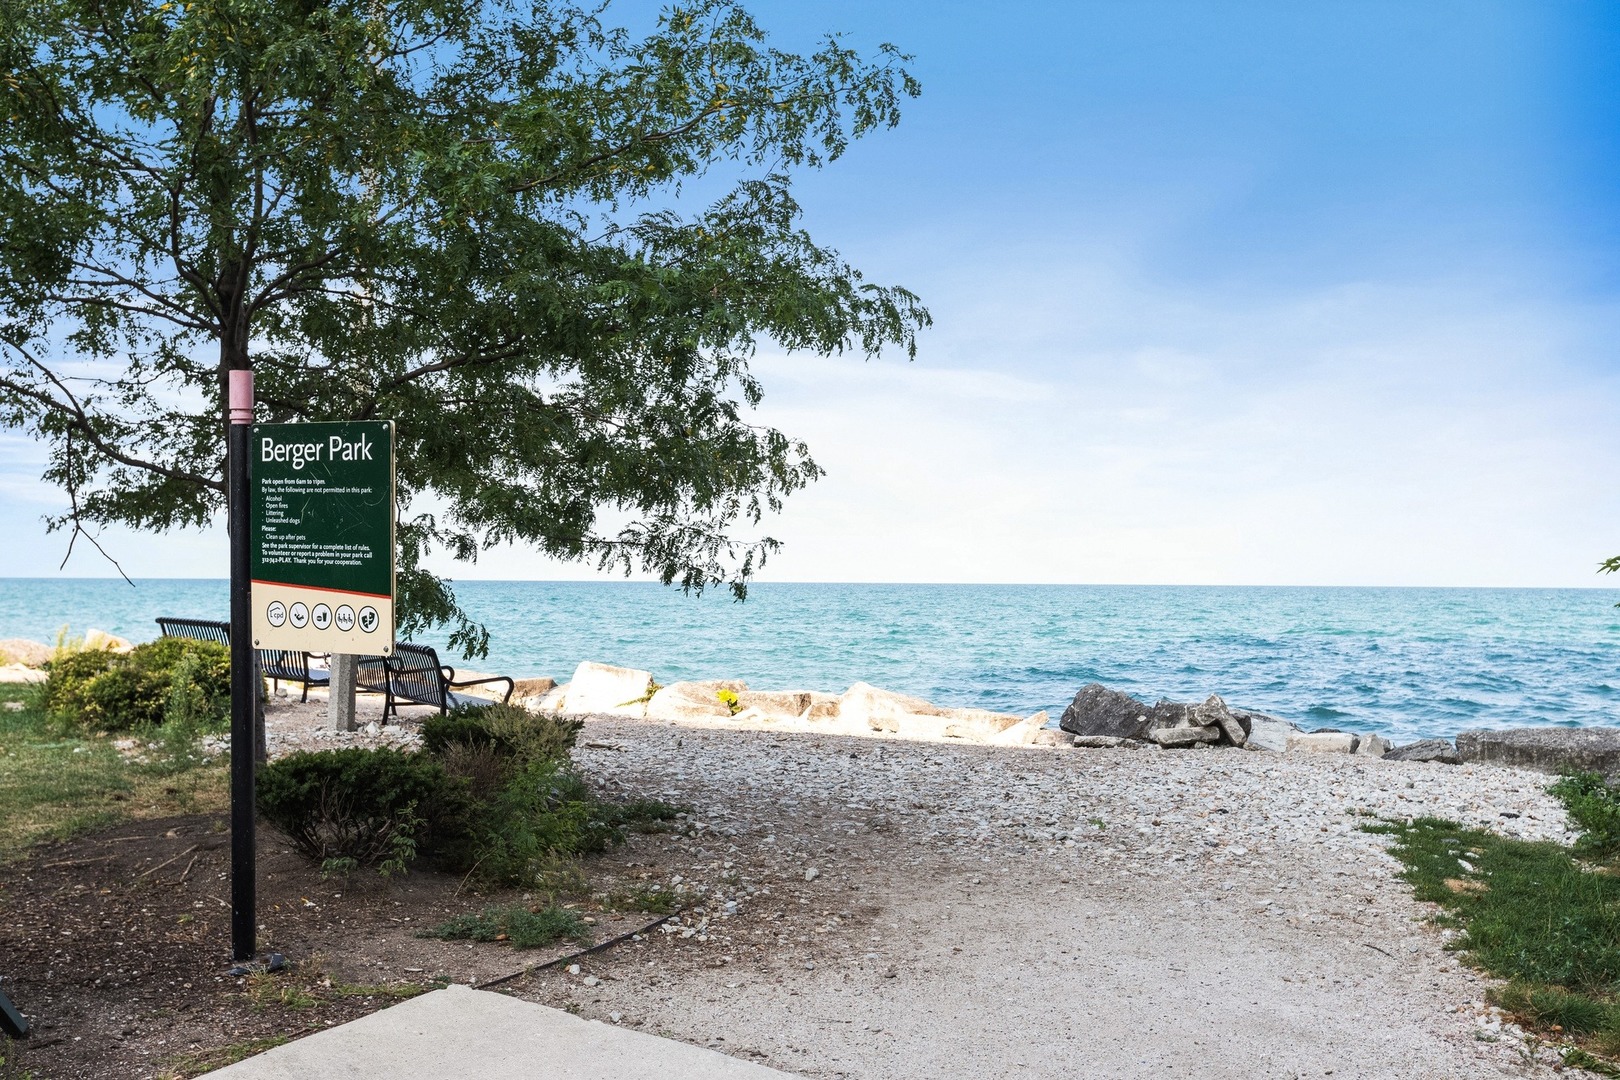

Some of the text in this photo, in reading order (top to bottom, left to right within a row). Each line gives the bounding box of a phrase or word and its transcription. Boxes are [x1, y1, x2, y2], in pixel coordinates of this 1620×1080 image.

[262, 433, 372, 470] Berger Park
[274, 611, 283, 620] cpd
